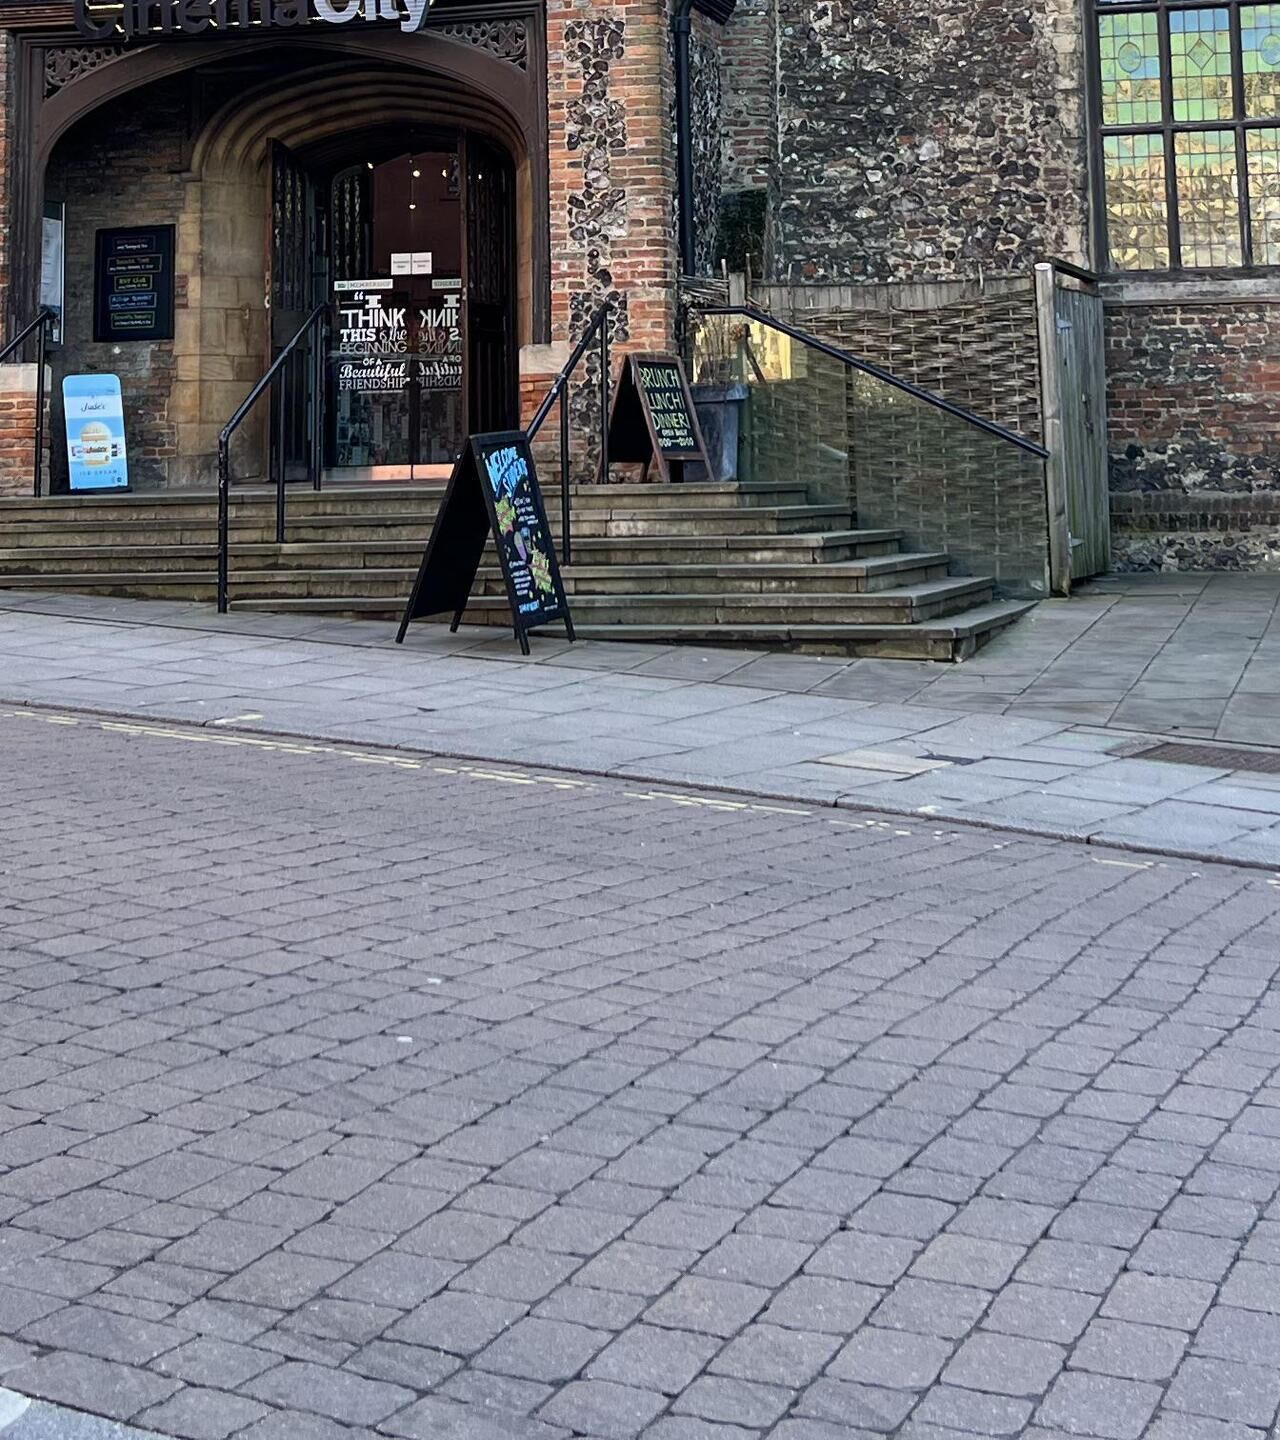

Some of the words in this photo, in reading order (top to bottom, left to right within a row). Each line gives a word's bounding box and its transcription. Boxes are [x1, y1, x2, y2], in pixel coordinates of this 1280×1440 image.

[340, 308, 406, 328] THINK
[340, 328, 376, 342] THIS
[388, 326, 407, 342] the
[340, 340, 407, 354] BEGINNING
[363, 358, 375, 366] OF
[339, 362, 406, 381] Beautiful
[639, 367, 681, 388] BRUNCH
